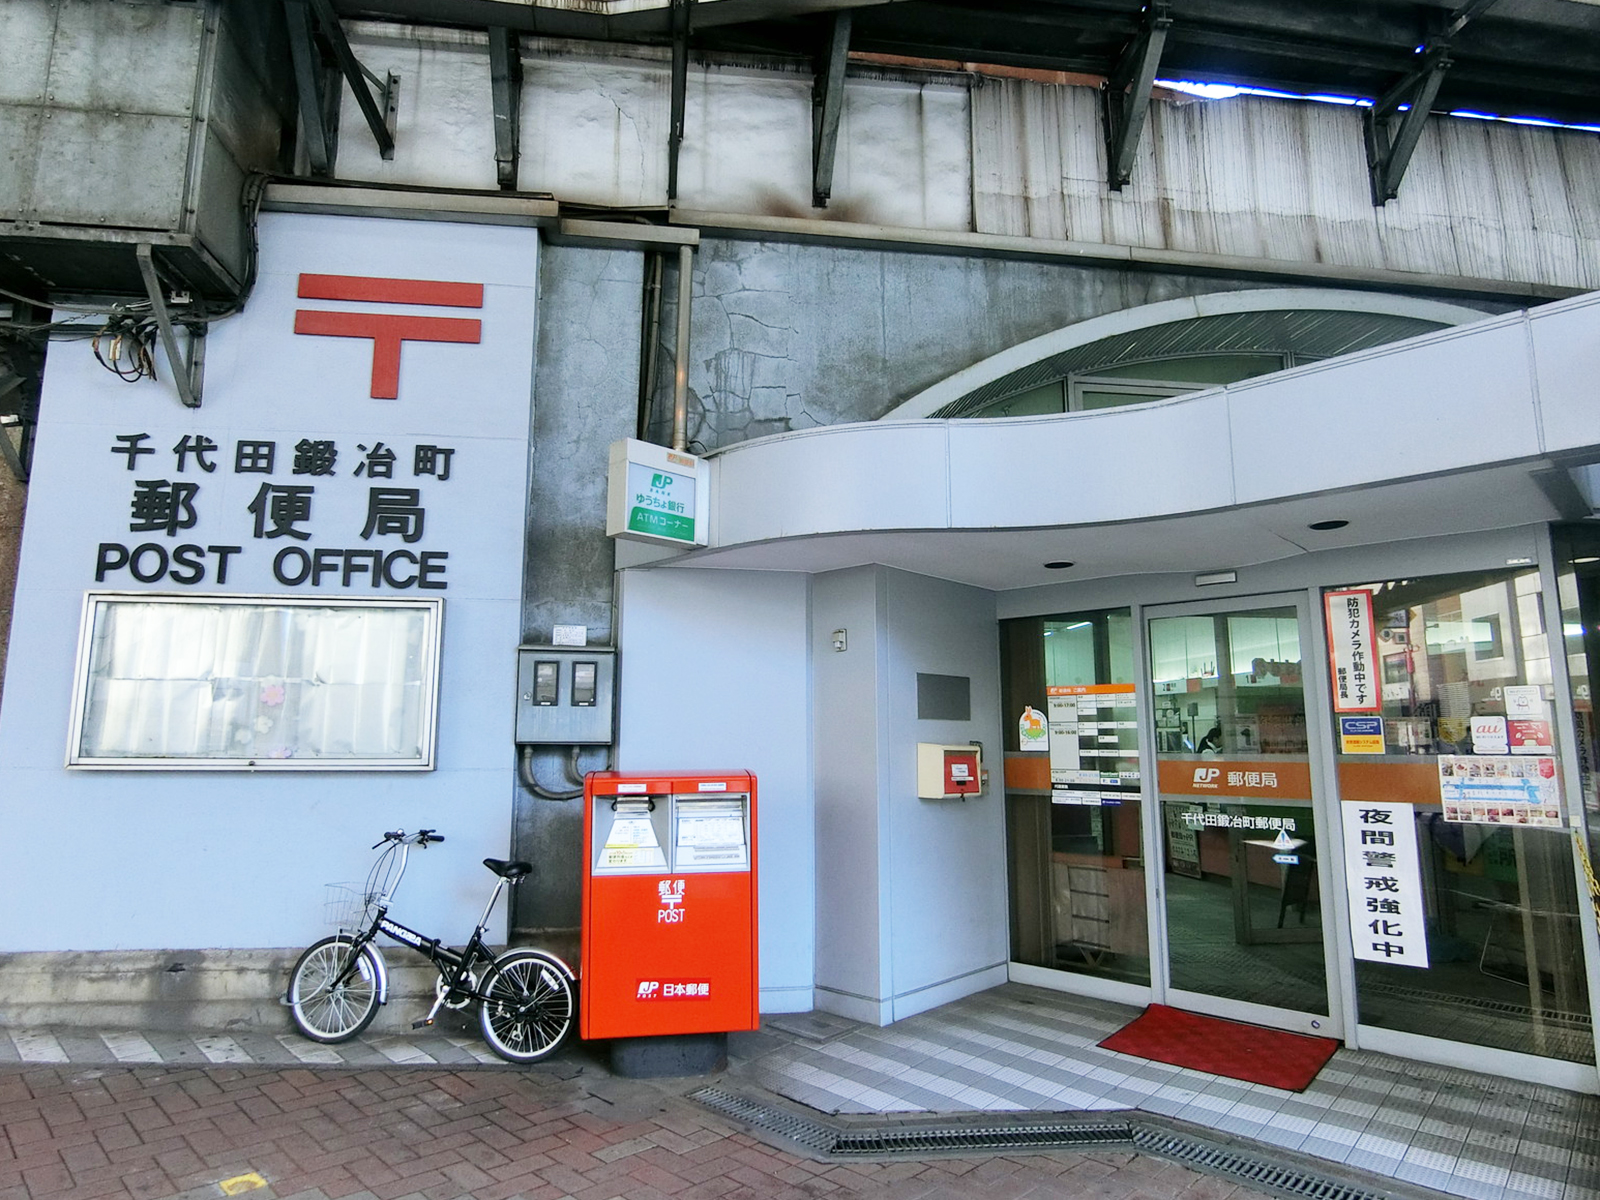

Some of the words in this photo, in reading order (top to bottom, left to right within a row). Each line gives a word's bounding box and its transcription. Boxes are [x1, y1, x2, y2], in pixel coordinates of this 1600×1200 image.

[111, 433, 455, 481] 千代田鍛冶町
[651, 473, 673, 489] JP
[130, 479, 426, 543] 郵便局
[636, 493, 685, 514] ゆうちょ銀行
[636, 512, 689, 528] ATMコーナー
[95, 542, 242, 584] POST
[273, 546, 449, 589] OFFICE
[1346, 597, 1367, 705] 防犯カメラ作動中です
[1337, 667, 1349, 699] 郵便局長
[1345, 721, 1378, 729] CSP
[1476, 724, 1502, 734] au
[1193, 768, 1220, 783] JP
[1227, 771, 1278, 788] 郵便局
[1181, 812, 1296, 831] 千代田鍛冶町郵便局
[658, 880, 685, 896] 郵便
[1358, 809, 1404, 957] 夜間警戒強化中
[658, 909, 685, 923] POST
[638, 982, 659, 994] JP
[663, 983, 709, 996] 日本郵便
